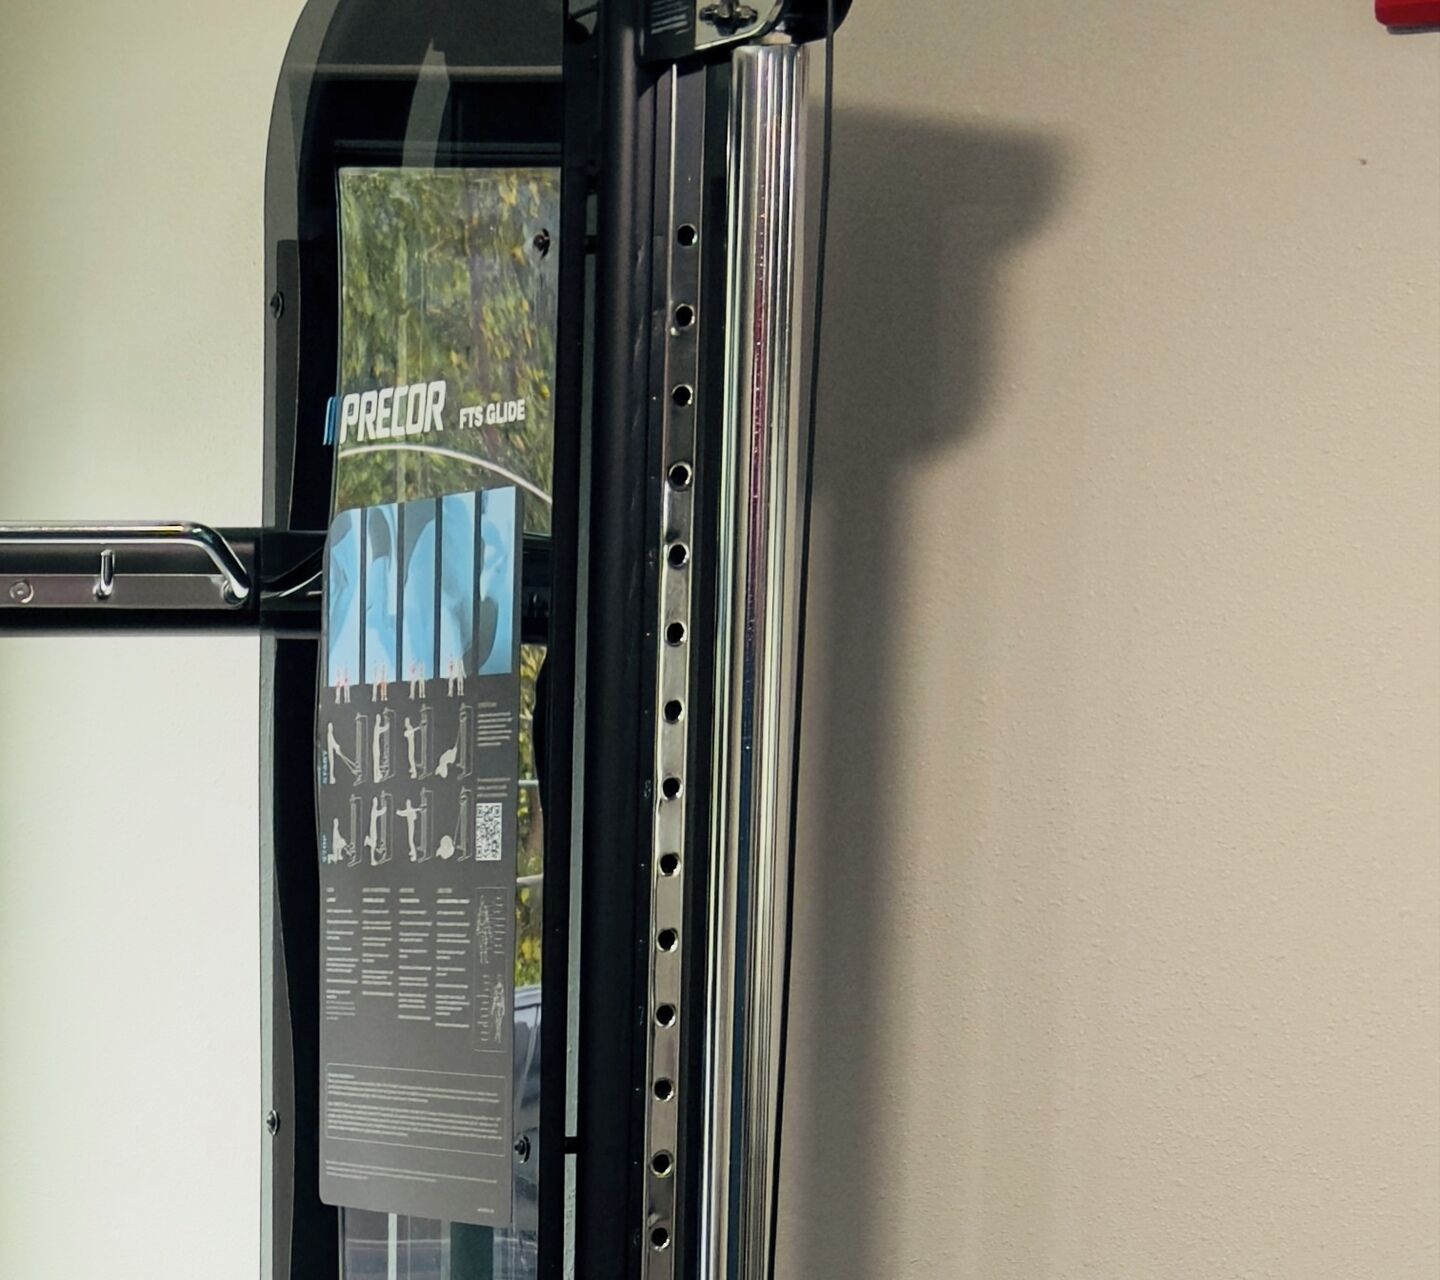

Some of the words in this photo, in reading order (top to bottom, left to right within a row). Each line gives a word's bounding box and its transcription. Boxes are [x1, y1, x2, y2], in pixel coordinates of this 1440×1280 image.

[339, 380, 447, 444] PRECOR
[459, 406, 484, 430] FTS
[486, 399, 526, 425] GLIDE
